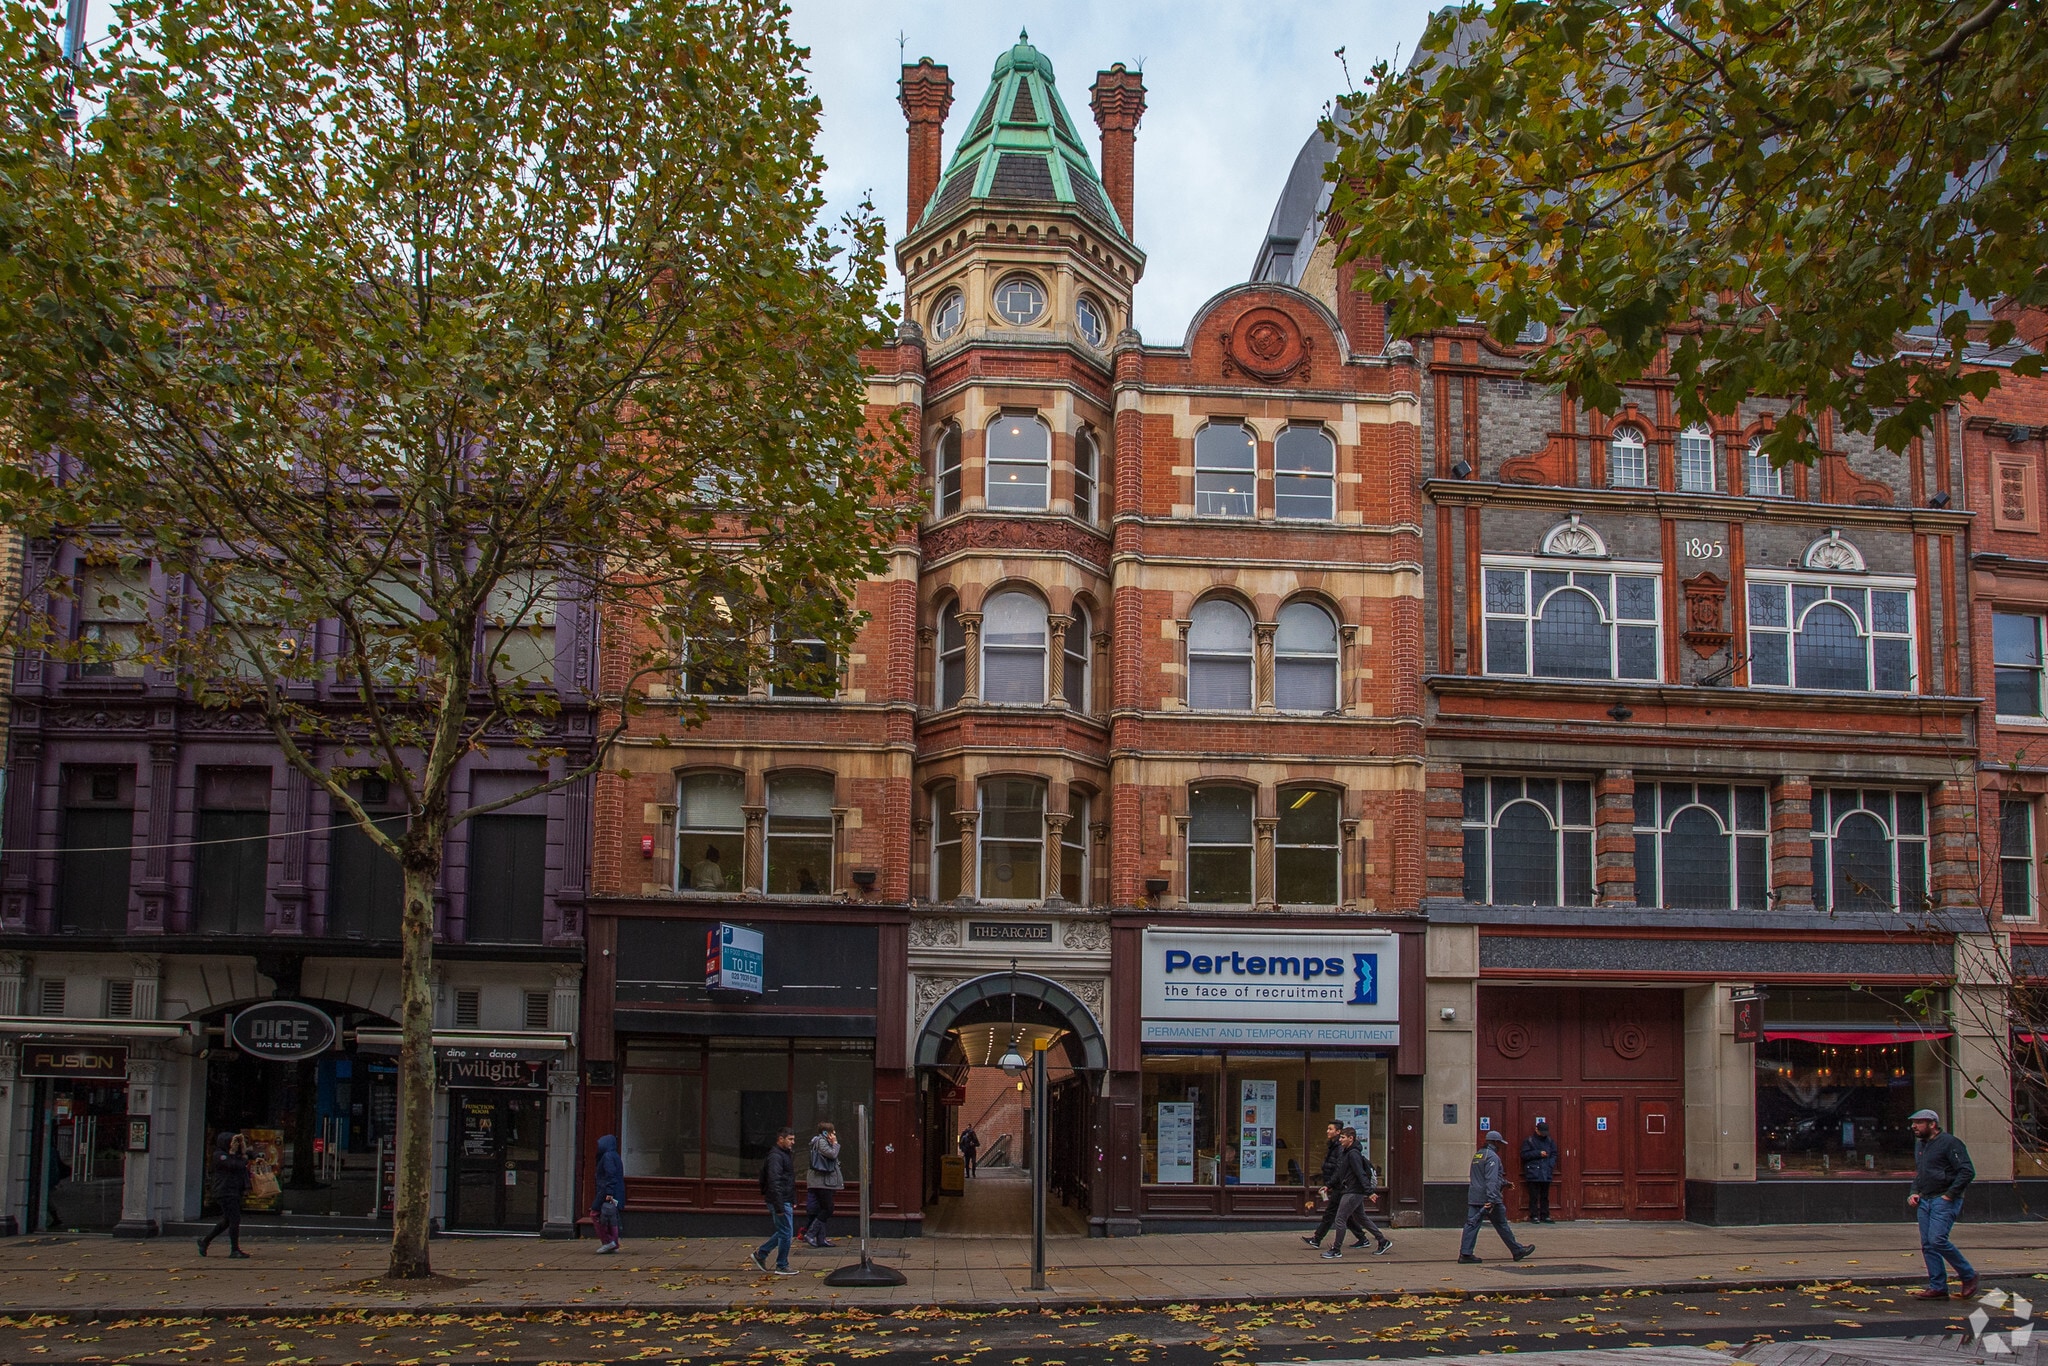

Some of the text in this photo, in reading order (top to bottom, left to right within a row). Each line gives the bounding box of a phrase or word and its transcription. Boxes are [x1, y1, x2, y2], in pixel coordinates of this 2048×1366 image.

[1685, 537, 1723, 560] 1895
[974, 926, 1048, 938] THE ARCADE
[732, 957, 743, 971] TO
[744, 959, 757, 974] LET
[1165, 949, 1345, 981] Pertemps
[1165, 985, 1344, 999] the face of recruitment
[251, 1020, 310, 1040] DICE
[1147, 1027, 1395, 1040] PERMANENT AND TEMPORARY RECRUITMENT
[35, 1054, 114, 1069] FUSION
[447, 1048, 518, 1059] dine dance
[443, 1058, 521, 1081] Twilight
